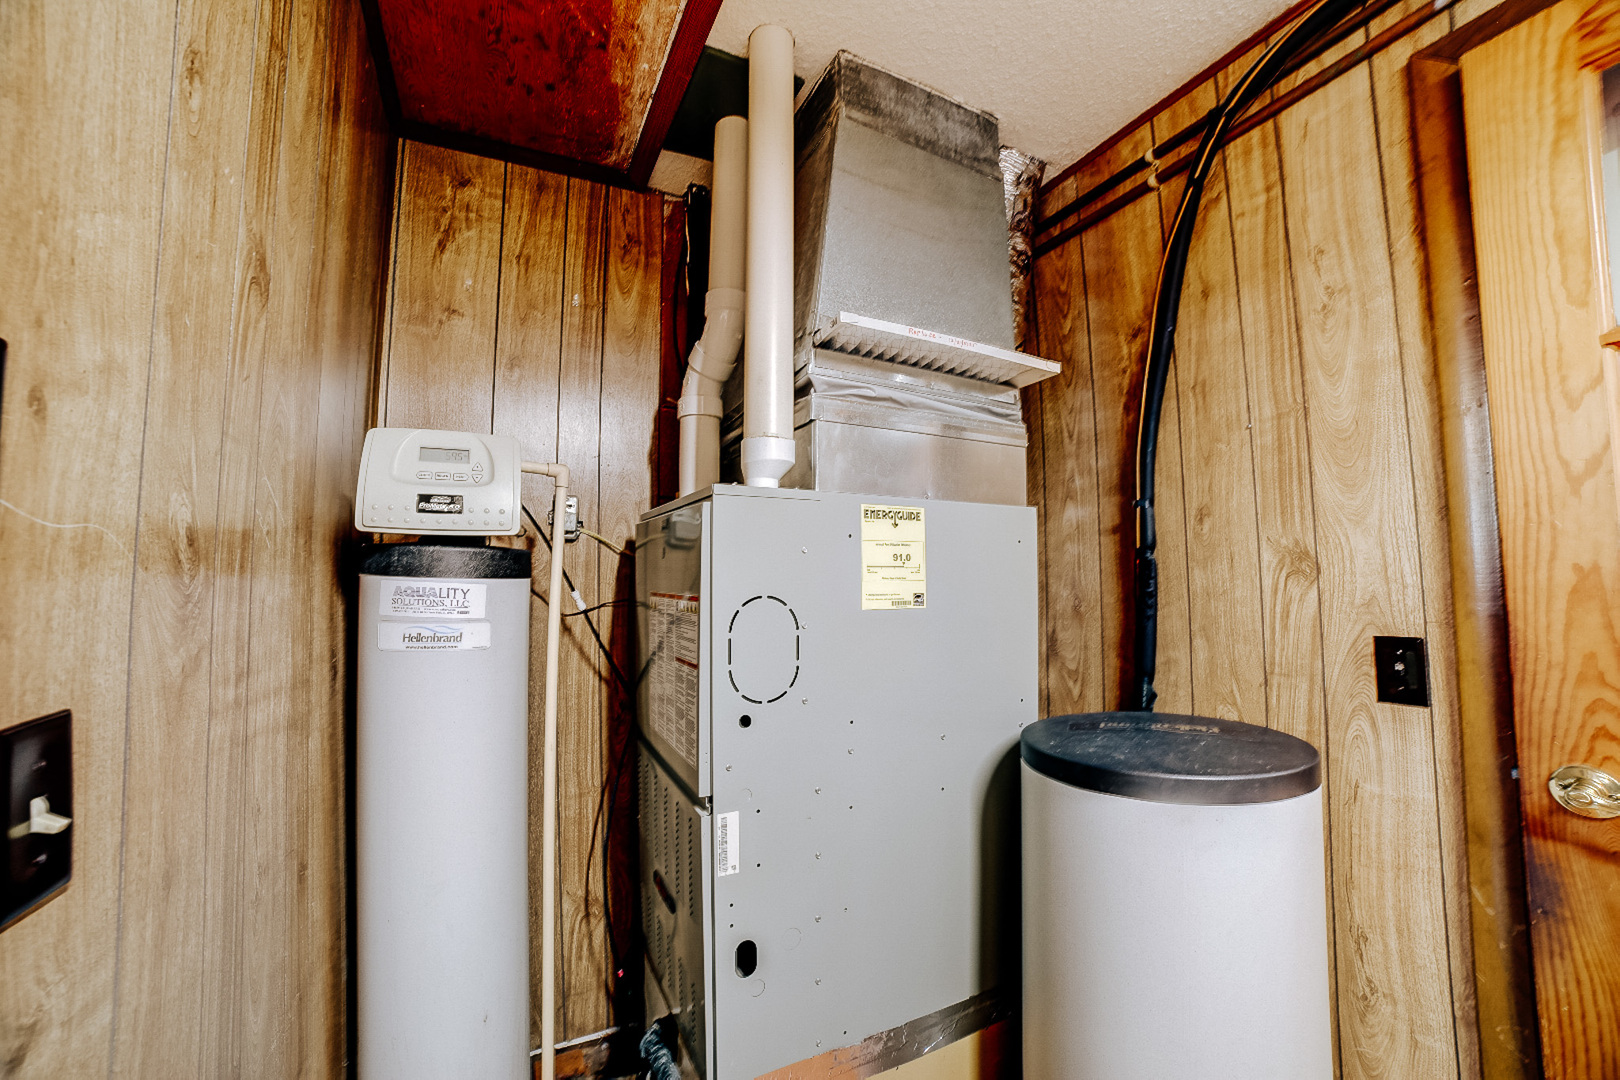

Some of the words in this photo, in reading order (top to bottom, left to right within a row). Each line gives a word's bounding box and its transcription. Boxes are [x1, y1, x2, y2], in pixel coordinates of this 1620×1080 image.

[893, 553, 911, 562] 91.0
[392, 585, 470, 600] AQUALITY
[402, 632, 463, 643] Hellenbrand
